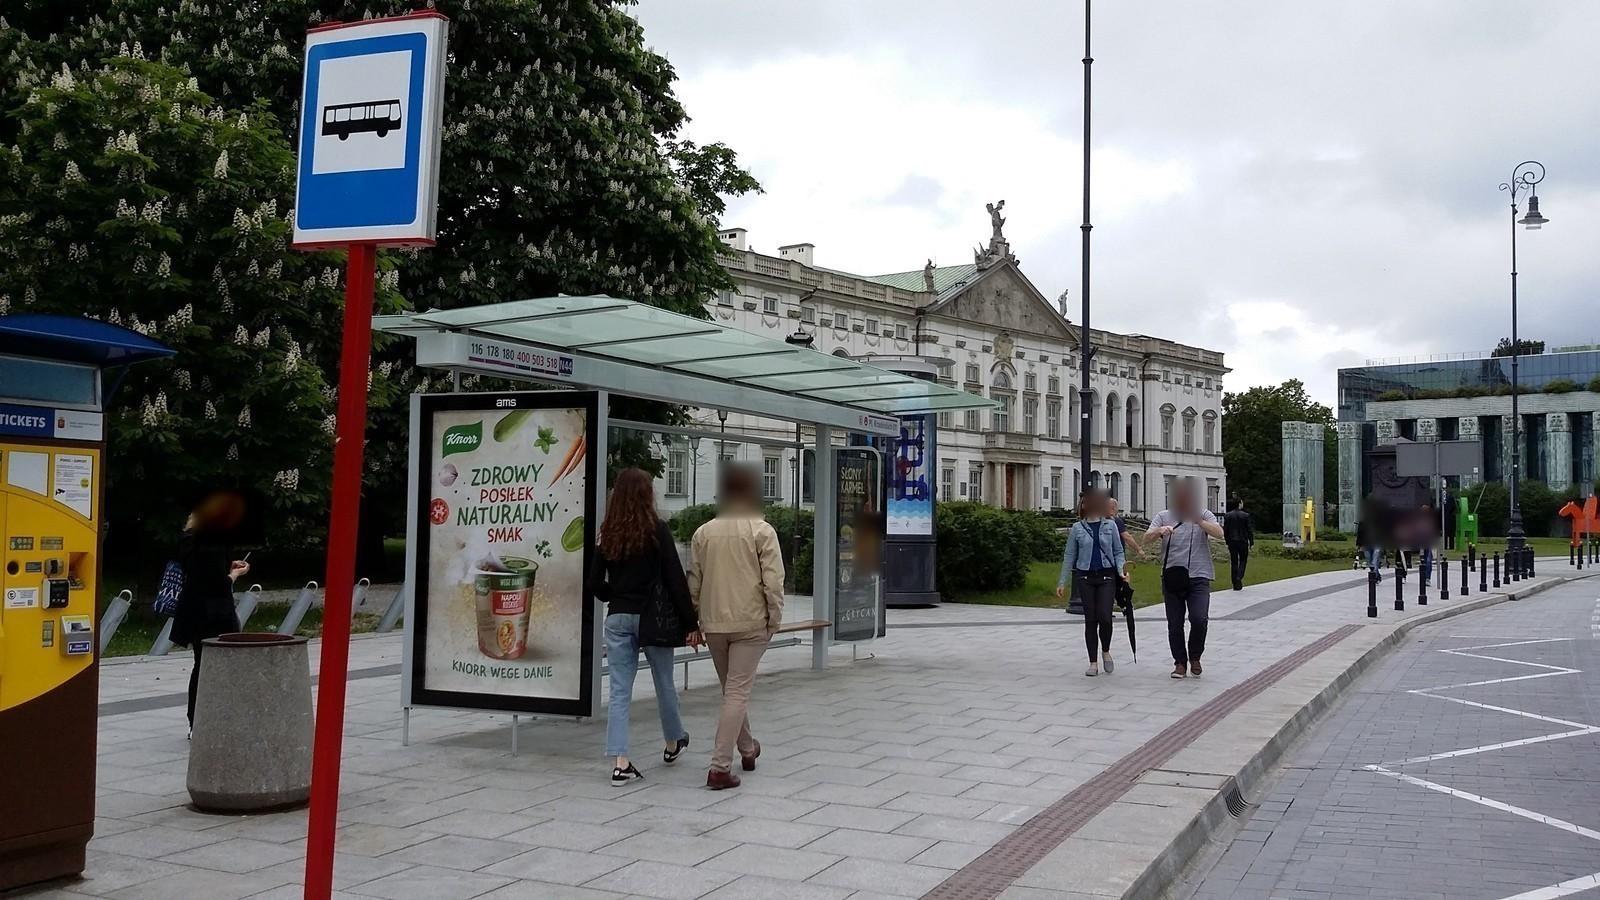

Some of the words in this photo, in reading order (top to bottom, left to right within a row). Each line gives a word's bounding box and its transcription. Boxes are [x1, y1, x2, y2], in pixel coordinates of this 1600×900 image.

[471, 343, 483, 355] 116
[486, 345, 500, 358] 178
[502, 348, 515, 360] 180
[516, 351, 531, 364] 400
[532, 354, 545, 367] 503
[546, 357, 558, 369] 518
[496, 398, 517, 407] ams
[0, 413, 46, 429] TICKETS
[446, 432, 479, 446] Knorr
[470, 463, 545, 487] ZDROWY
[840, 466, 862, 480] SŁONY
[479, 486, 535, 504] POSIŁEK
[840, 480, 865, 495] KARMEL
[456, 501, 559, 526] NATURALNY
[487, 526, 523, 543] SMAK
[452, 659, 487, 678] KNORR
[490, 666, 520, 679] WEGE
[523, 666, 553, 679] DANIE
